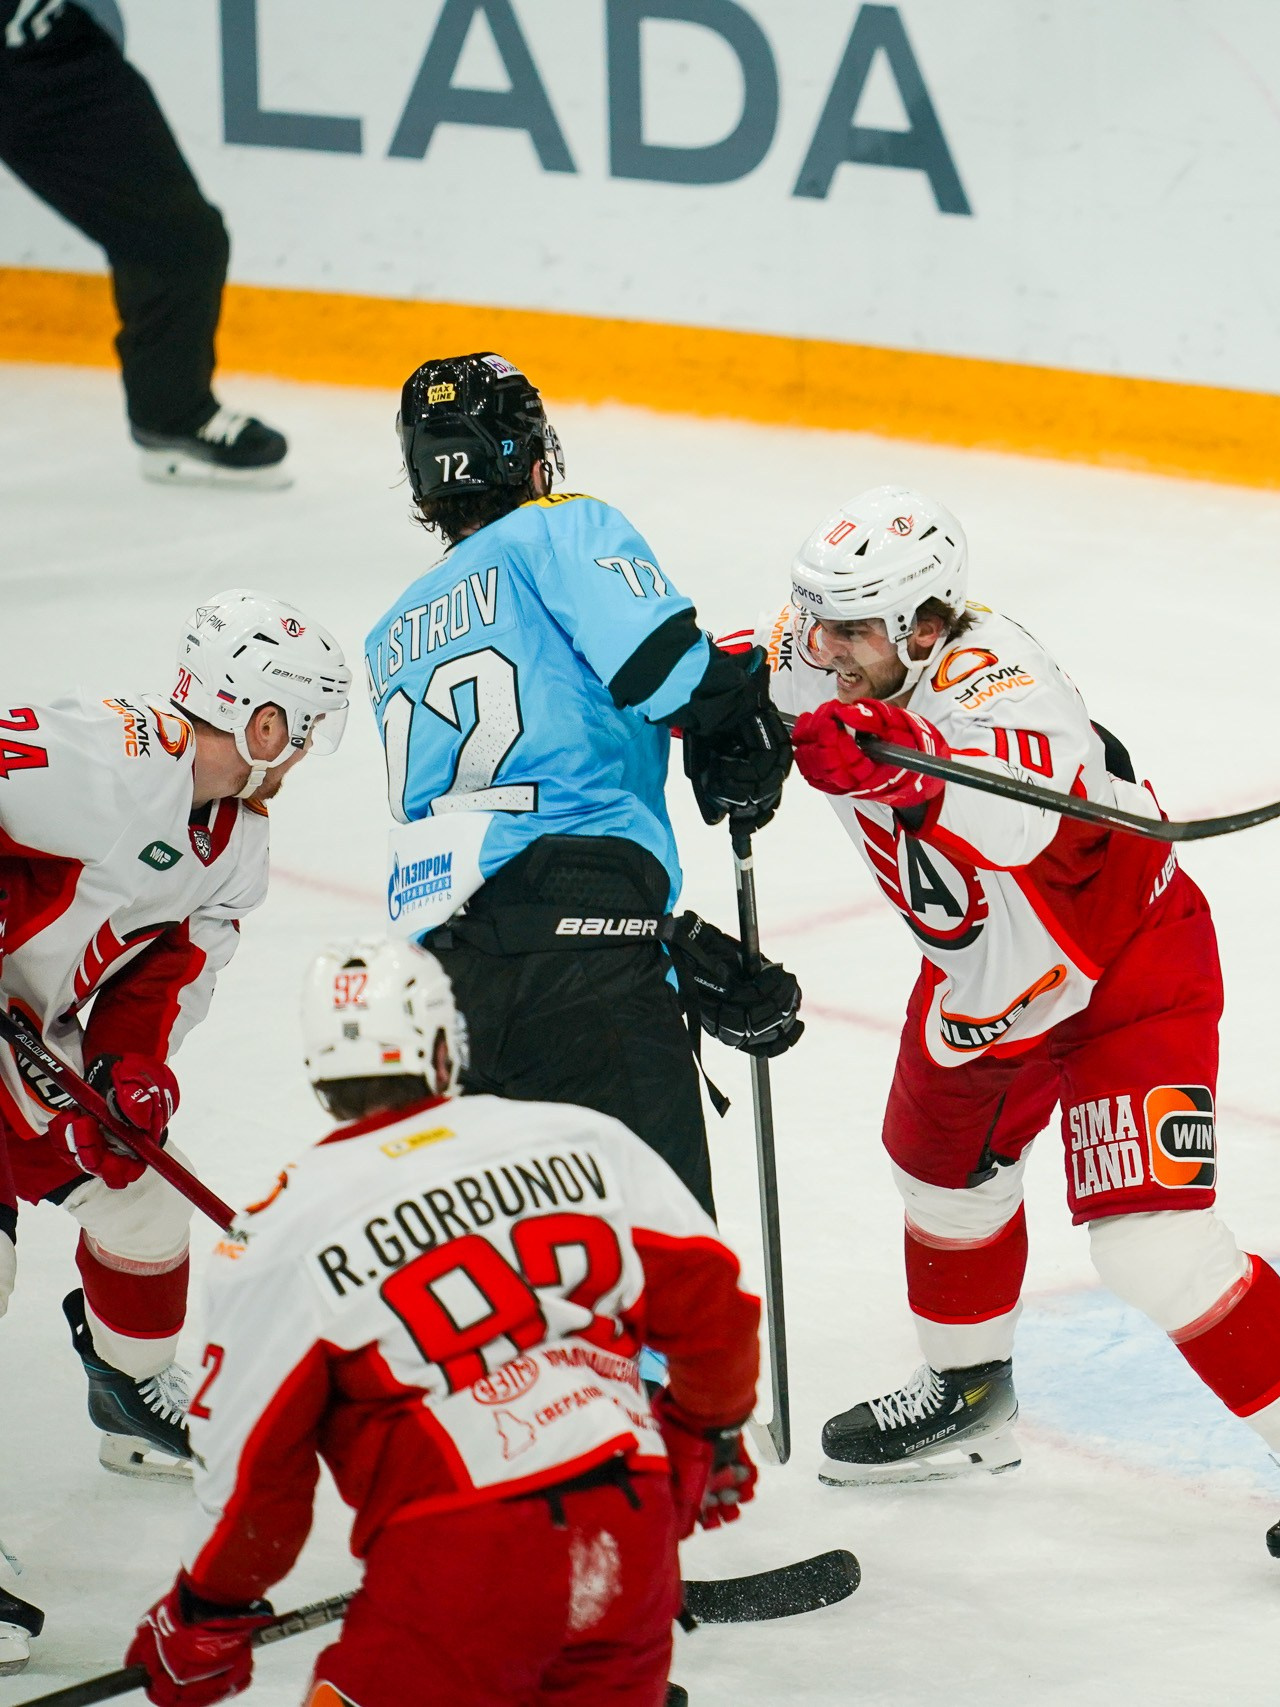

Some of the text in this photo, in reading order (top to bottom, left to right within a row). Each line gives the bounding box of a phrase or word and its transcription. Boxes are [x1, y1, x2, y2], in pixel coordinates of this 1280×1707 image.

[221, 0, 974, 217] LADA
[431, 393, 452, 402] LINE
[435, 452, 471, 482] 72
[824, 520, 857, 546] 10
[172, 667, 192, 703] 24
[271, 668, 313, 685] BAUER
[962, 675, 1036, 710] UMMC
[993, 727, 1054, 779] 10
[401, 851, 452, 889] ГАЗПРОМ
[555, 918, 658, 936] BAUER
[334, 973, 368, 1004] 92
[1069, 1094, 1139, 1152] SIMA
[1173, 1121, 1212, 1151] WIN
[1071, 1140, 1145, 1200] LAND
[317, 1151, 607, 1297] R.GORBUNOV
[380, 1212, 642, 1397] 92
[905, 1423, 957, 1454] BAUER
